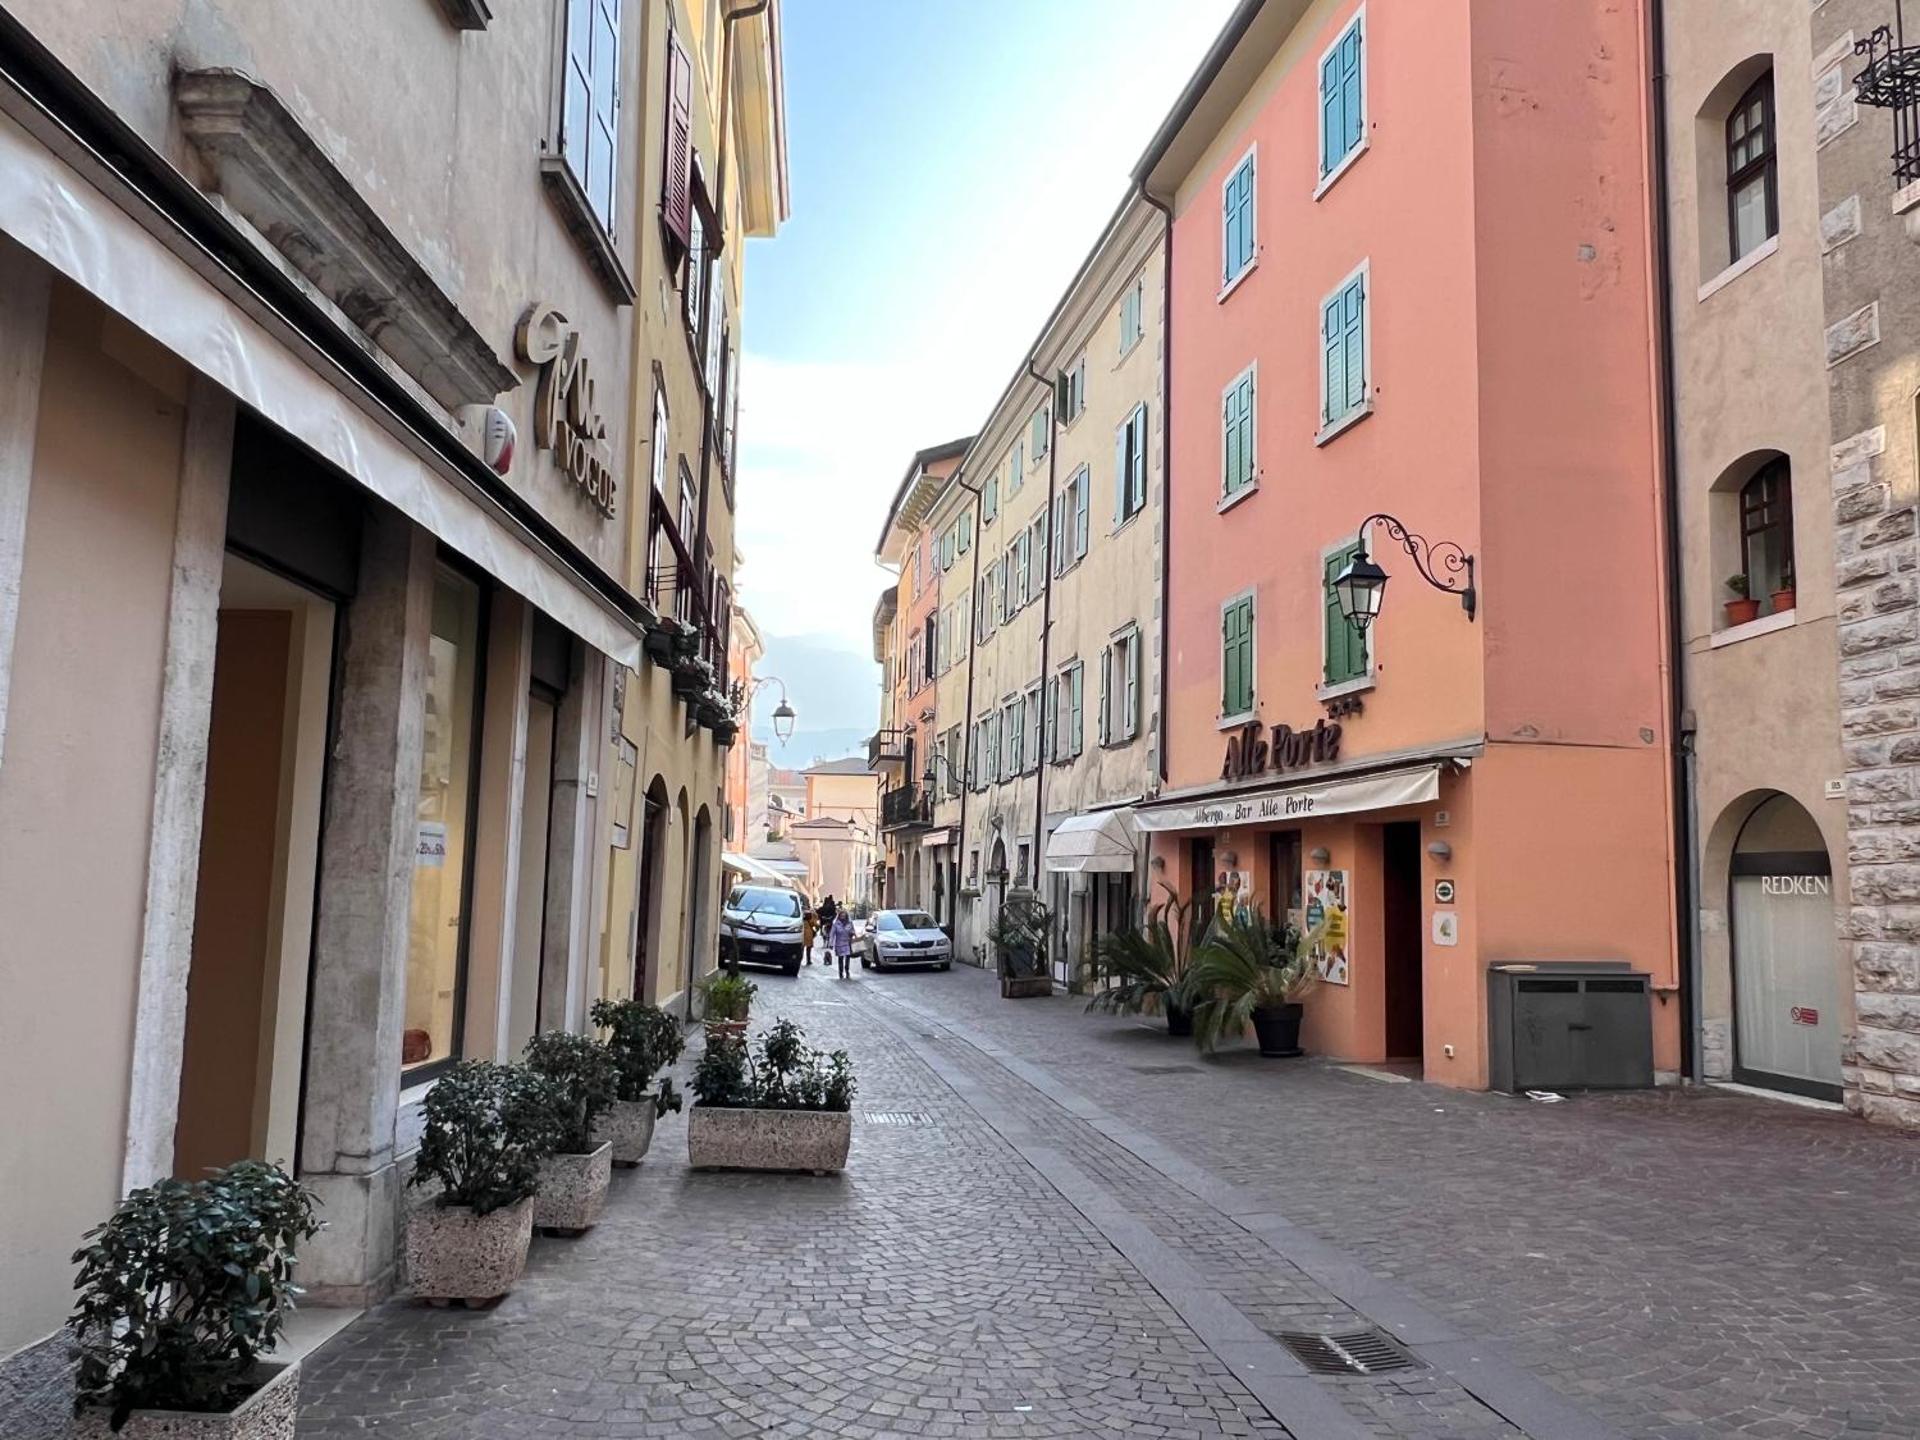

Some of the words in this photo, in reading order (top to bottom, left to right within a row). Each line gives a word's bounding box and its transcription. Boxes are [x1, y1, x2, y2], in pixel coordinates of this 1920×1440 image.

[561, 421, 616, 518] VOGUE
[1220, 720, 1268, 780] Alle
[1268, 718, 1342, 770] Porte
[1193, 806, 1224, 825] Albergo
[1235, 803, 1253, 820] Bar
[1259, 798, 1279, 817] Alle
[1285, 795, 1315, 814] Porte
[1761, 875, 1829, 895] REDKEN
